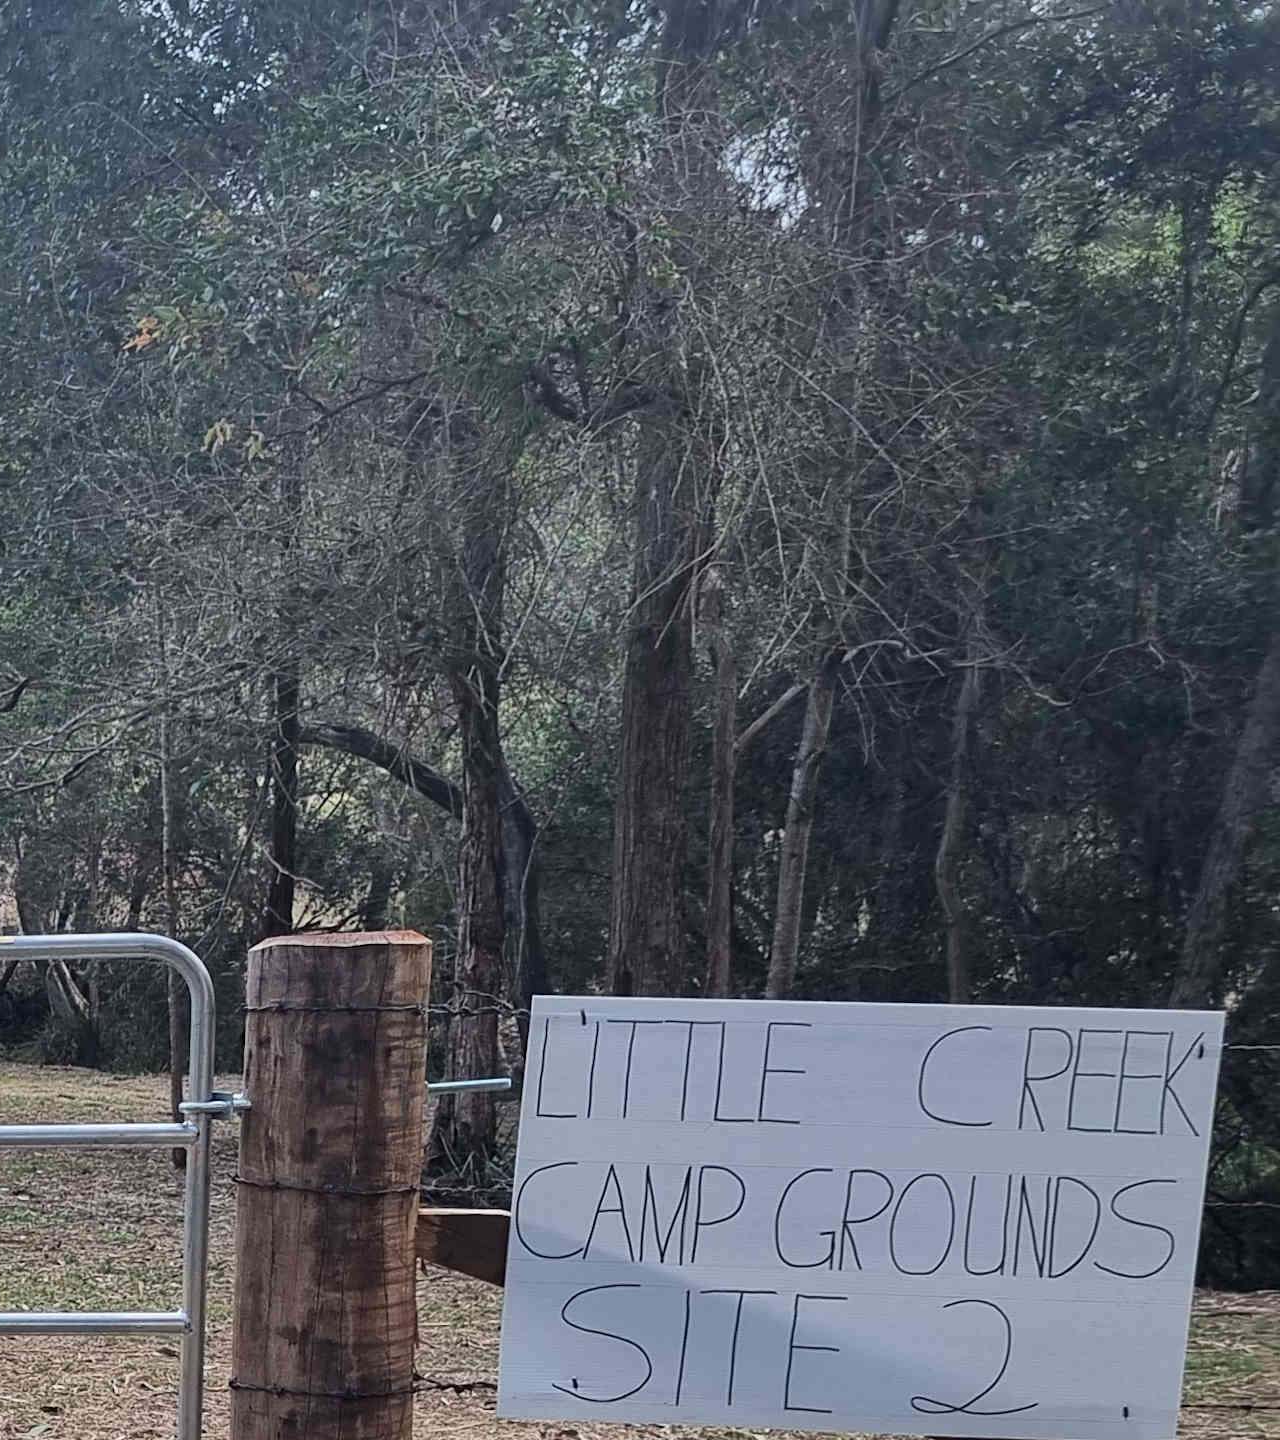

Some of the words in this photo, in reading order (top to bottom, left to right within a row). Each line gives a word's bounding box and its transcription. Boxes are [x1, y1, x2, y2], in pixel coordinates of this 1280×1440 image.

[535, 1017, 813, 1124] LITTLE
[917, 1025, 1203, 1138] CREEK
[515, 1161, 747, 1267] CAMP
[775, 1167, 1178, 1279] GROUNDS
[551, 1283, 849, 1414] SITE
[910, 1298, 1039, 1415] 2
